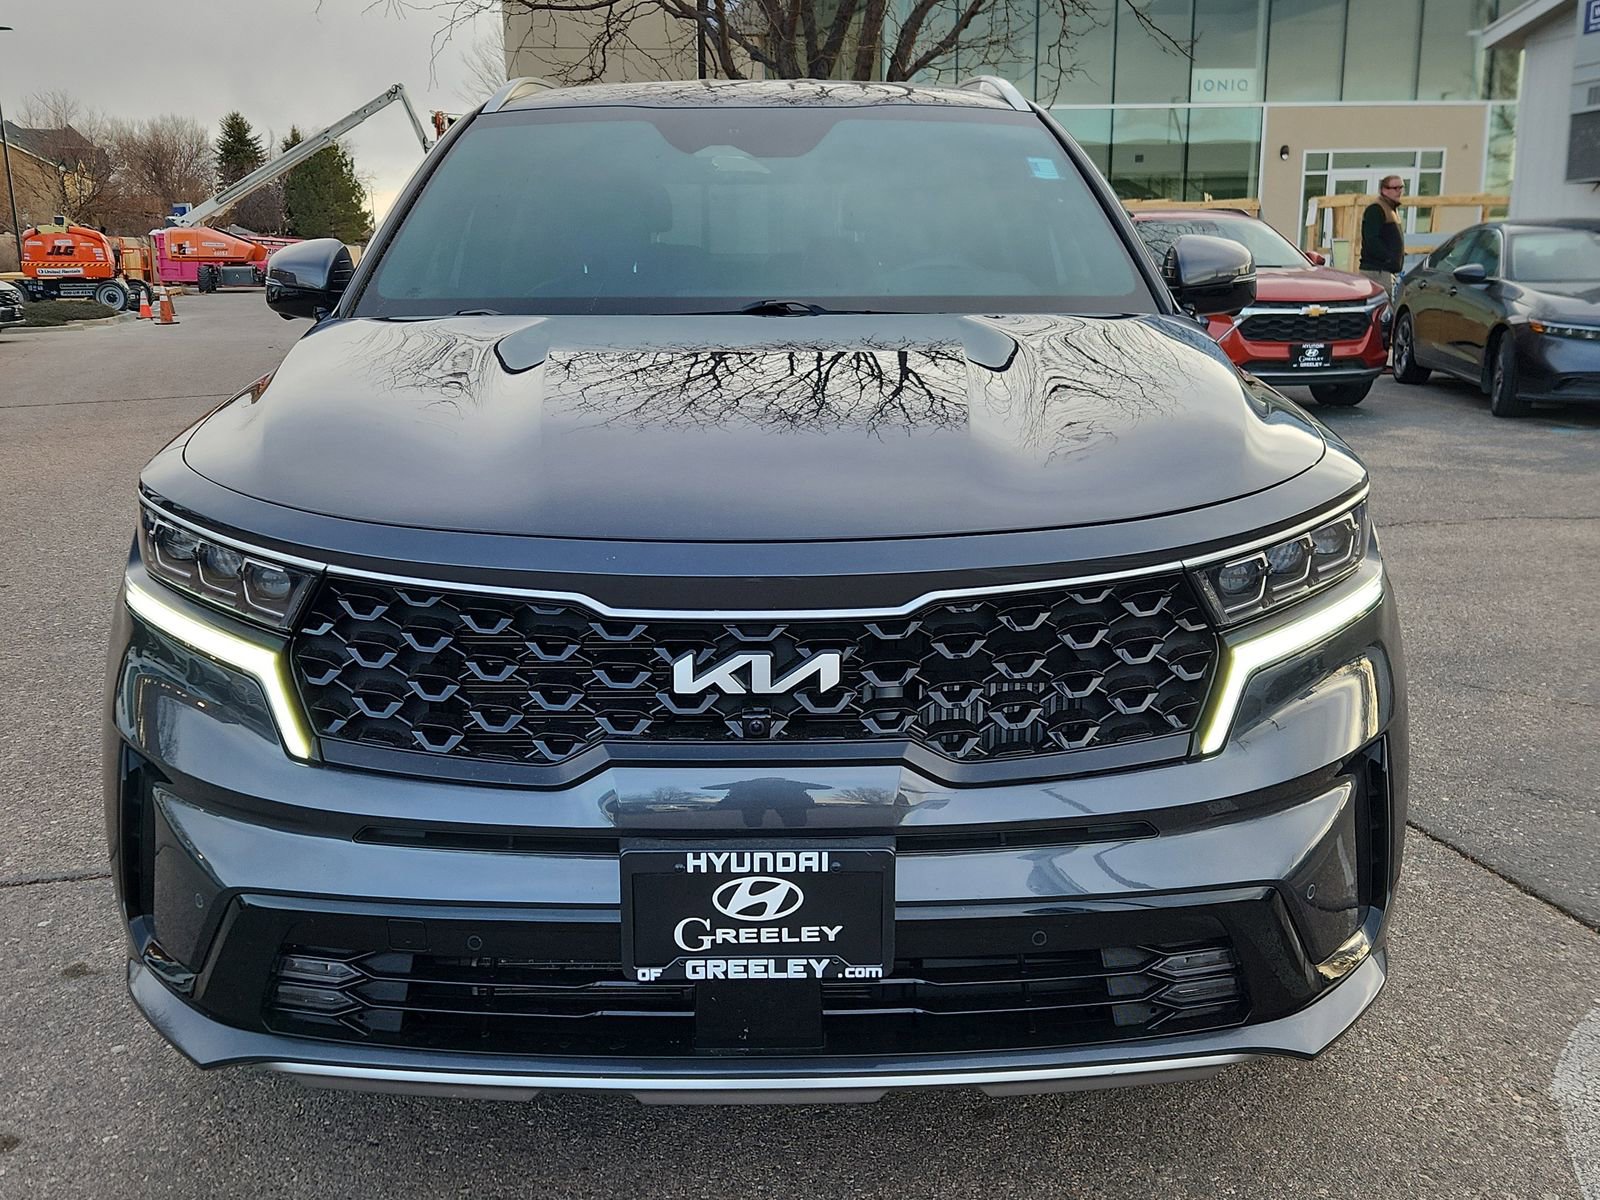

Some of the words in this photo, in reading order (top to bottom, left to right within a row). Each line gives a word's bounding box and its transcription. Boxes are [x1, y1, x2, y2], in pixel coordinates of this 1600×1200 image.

[1197, 79, 1249, 92] IONIQ
[46, 246, 76, 256] JLG
[673, 654, 841, 694] KIA
[686, 852, 829, 873] HYUNDAI
[673, 917, 843, 951] GREELEY
[685, 958, 830, 979] GREELEY
[837, 966, 883, 978] .com
